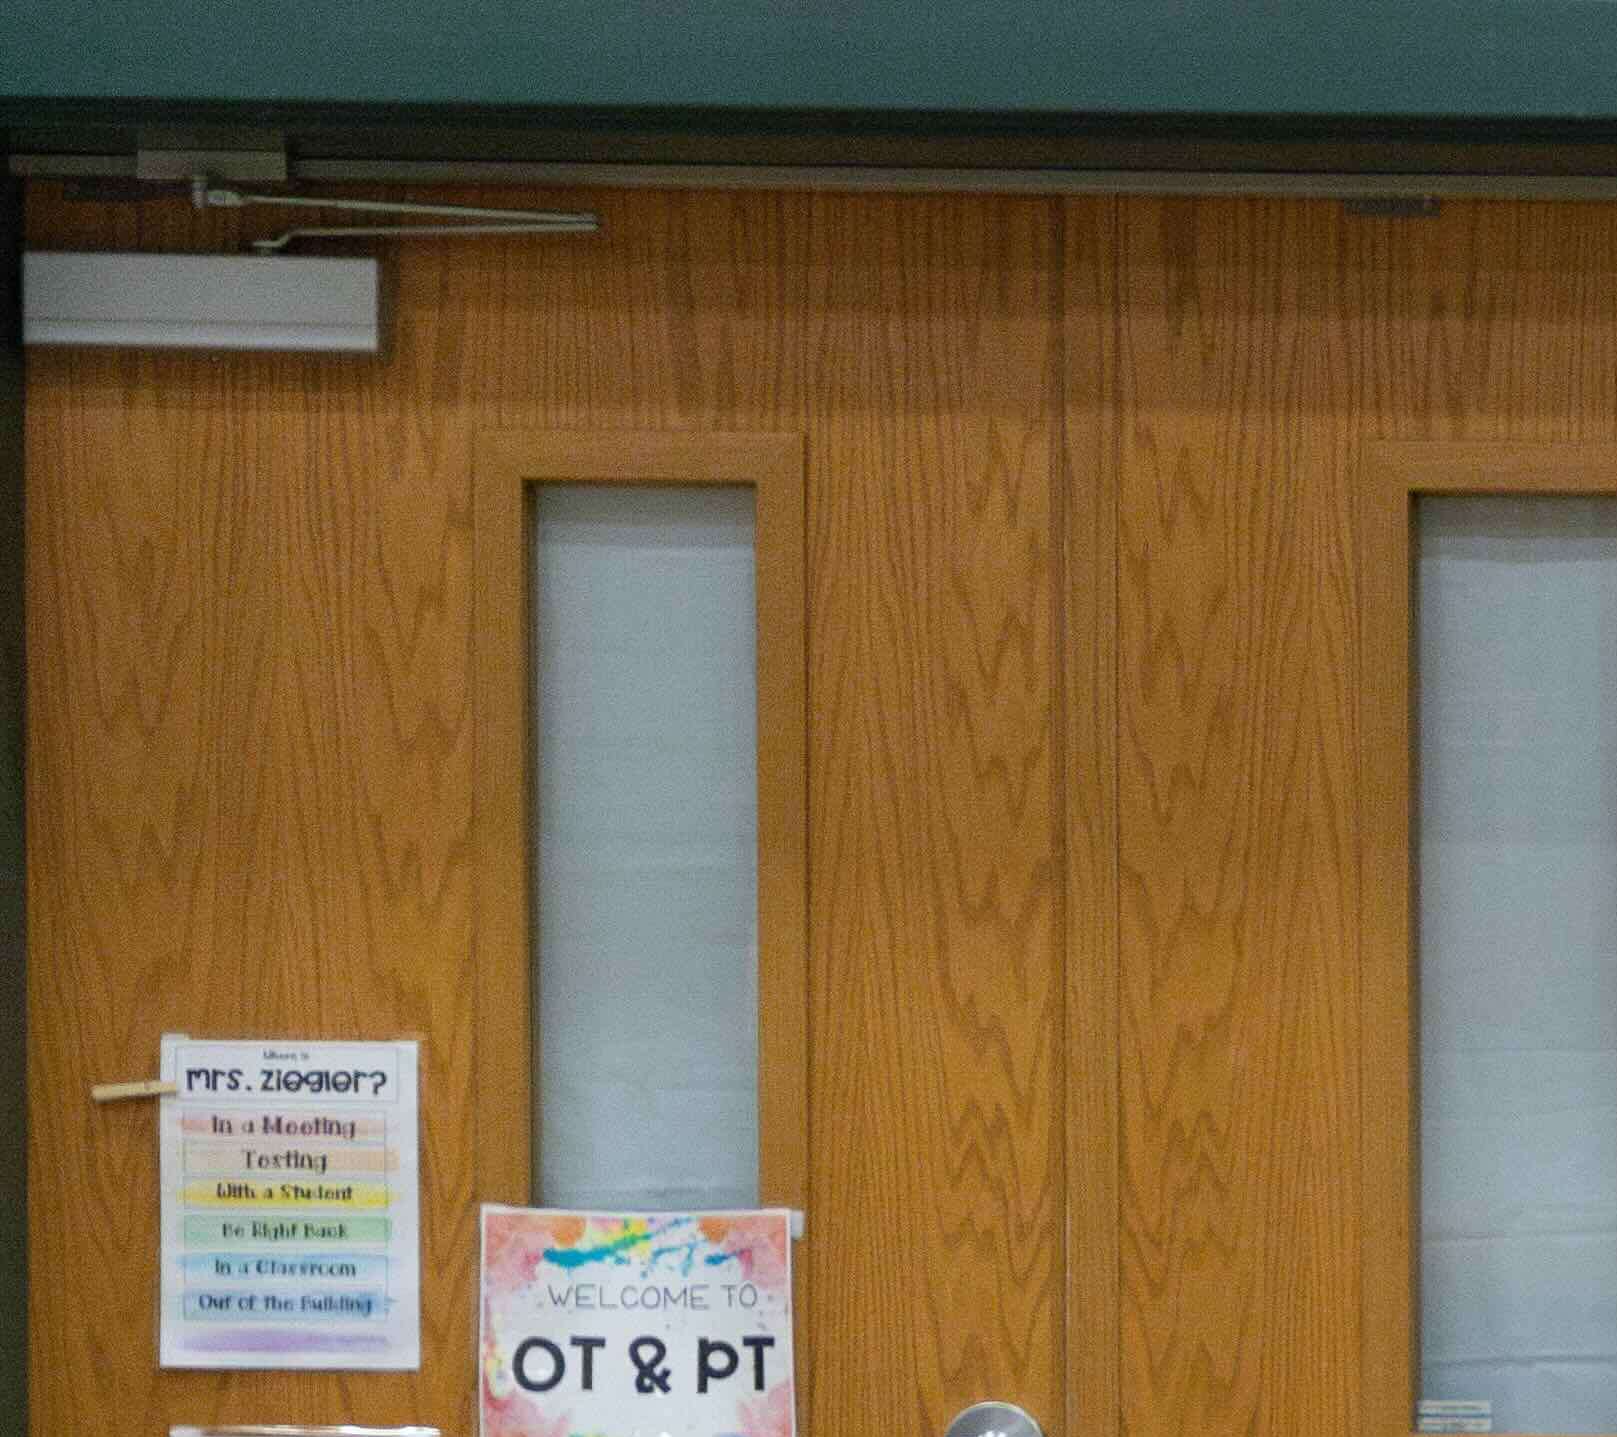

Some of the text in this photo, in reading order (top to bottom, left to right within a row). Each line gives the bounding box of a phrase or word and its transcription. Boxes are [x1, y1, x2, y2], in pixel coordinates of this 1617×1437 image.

[262, 1115, 357, 1140] Meeting
[547, 1283, 758, 1310] WELCOME TO
[512, 1335, 776, 1394] OT & PT
